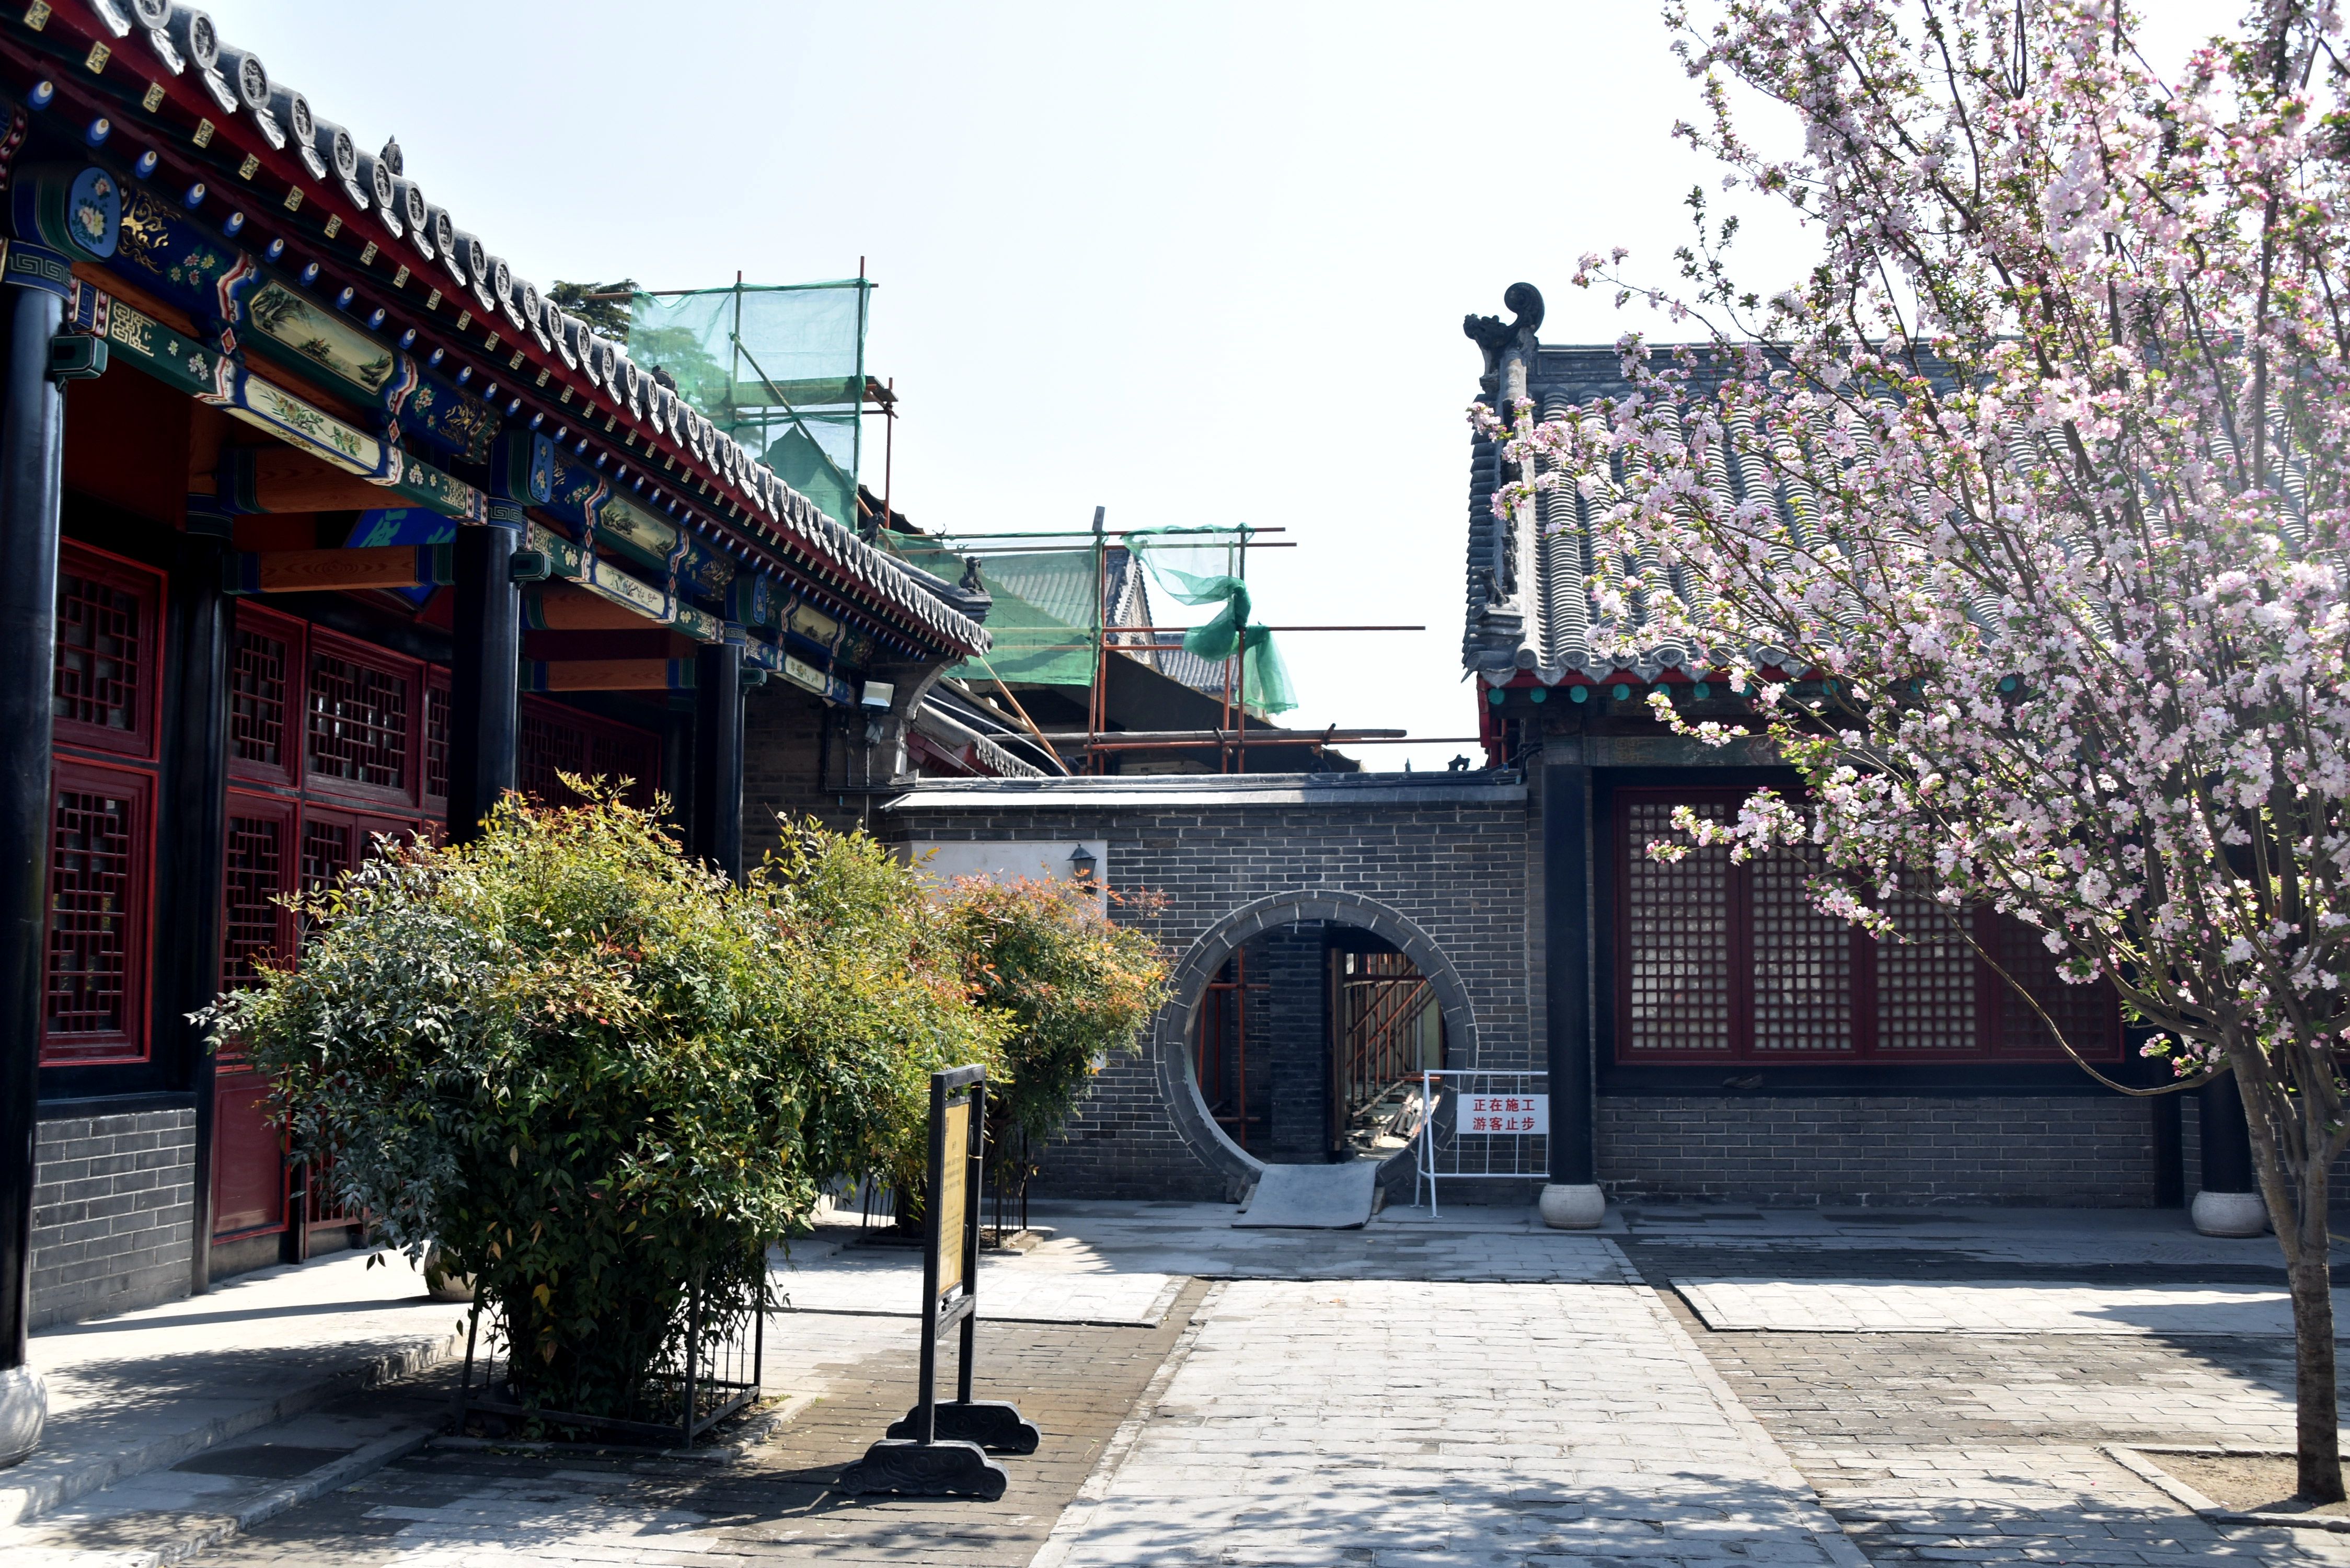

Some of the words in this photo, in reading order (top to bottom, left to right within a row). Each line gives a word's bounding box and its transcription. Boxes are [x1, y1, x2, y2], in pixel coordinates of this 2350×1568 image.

[1473, 1099, 1535, 1112] 正在施工
[1473, 1116, 1535, 1131] 游客止步
